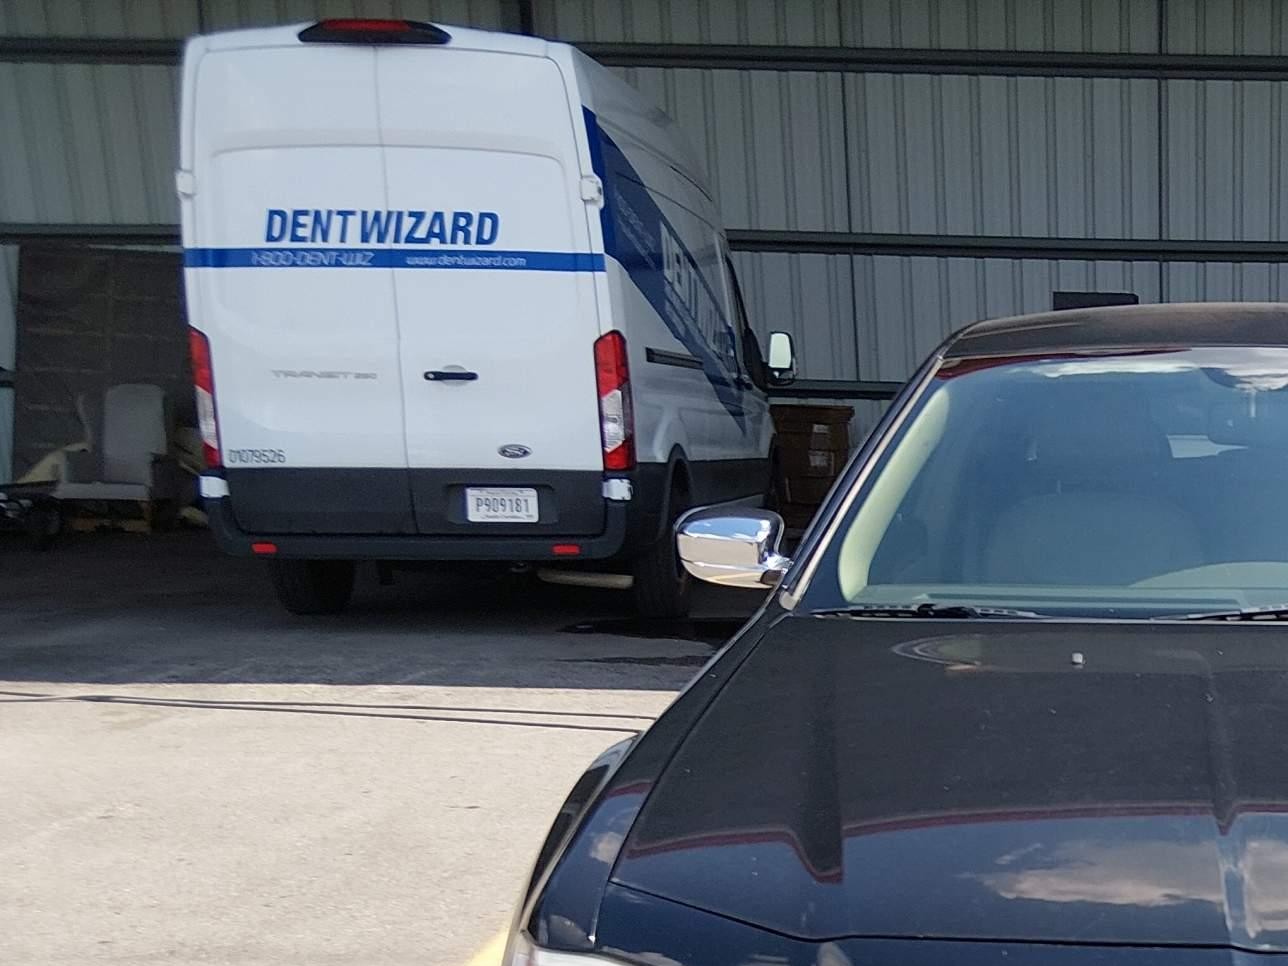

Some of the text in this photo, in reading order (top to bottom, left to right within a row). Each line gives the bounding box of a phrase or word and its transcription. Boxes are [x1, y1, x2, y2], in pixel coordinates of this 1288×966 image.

[251, 250, 375, 266] 1-800-DENT-WIZ
[405, 253, 527, 267] www.dentwizard.com
[228, 449, 286, 463] 01079526
[475, 497, 530, 512] P909181
